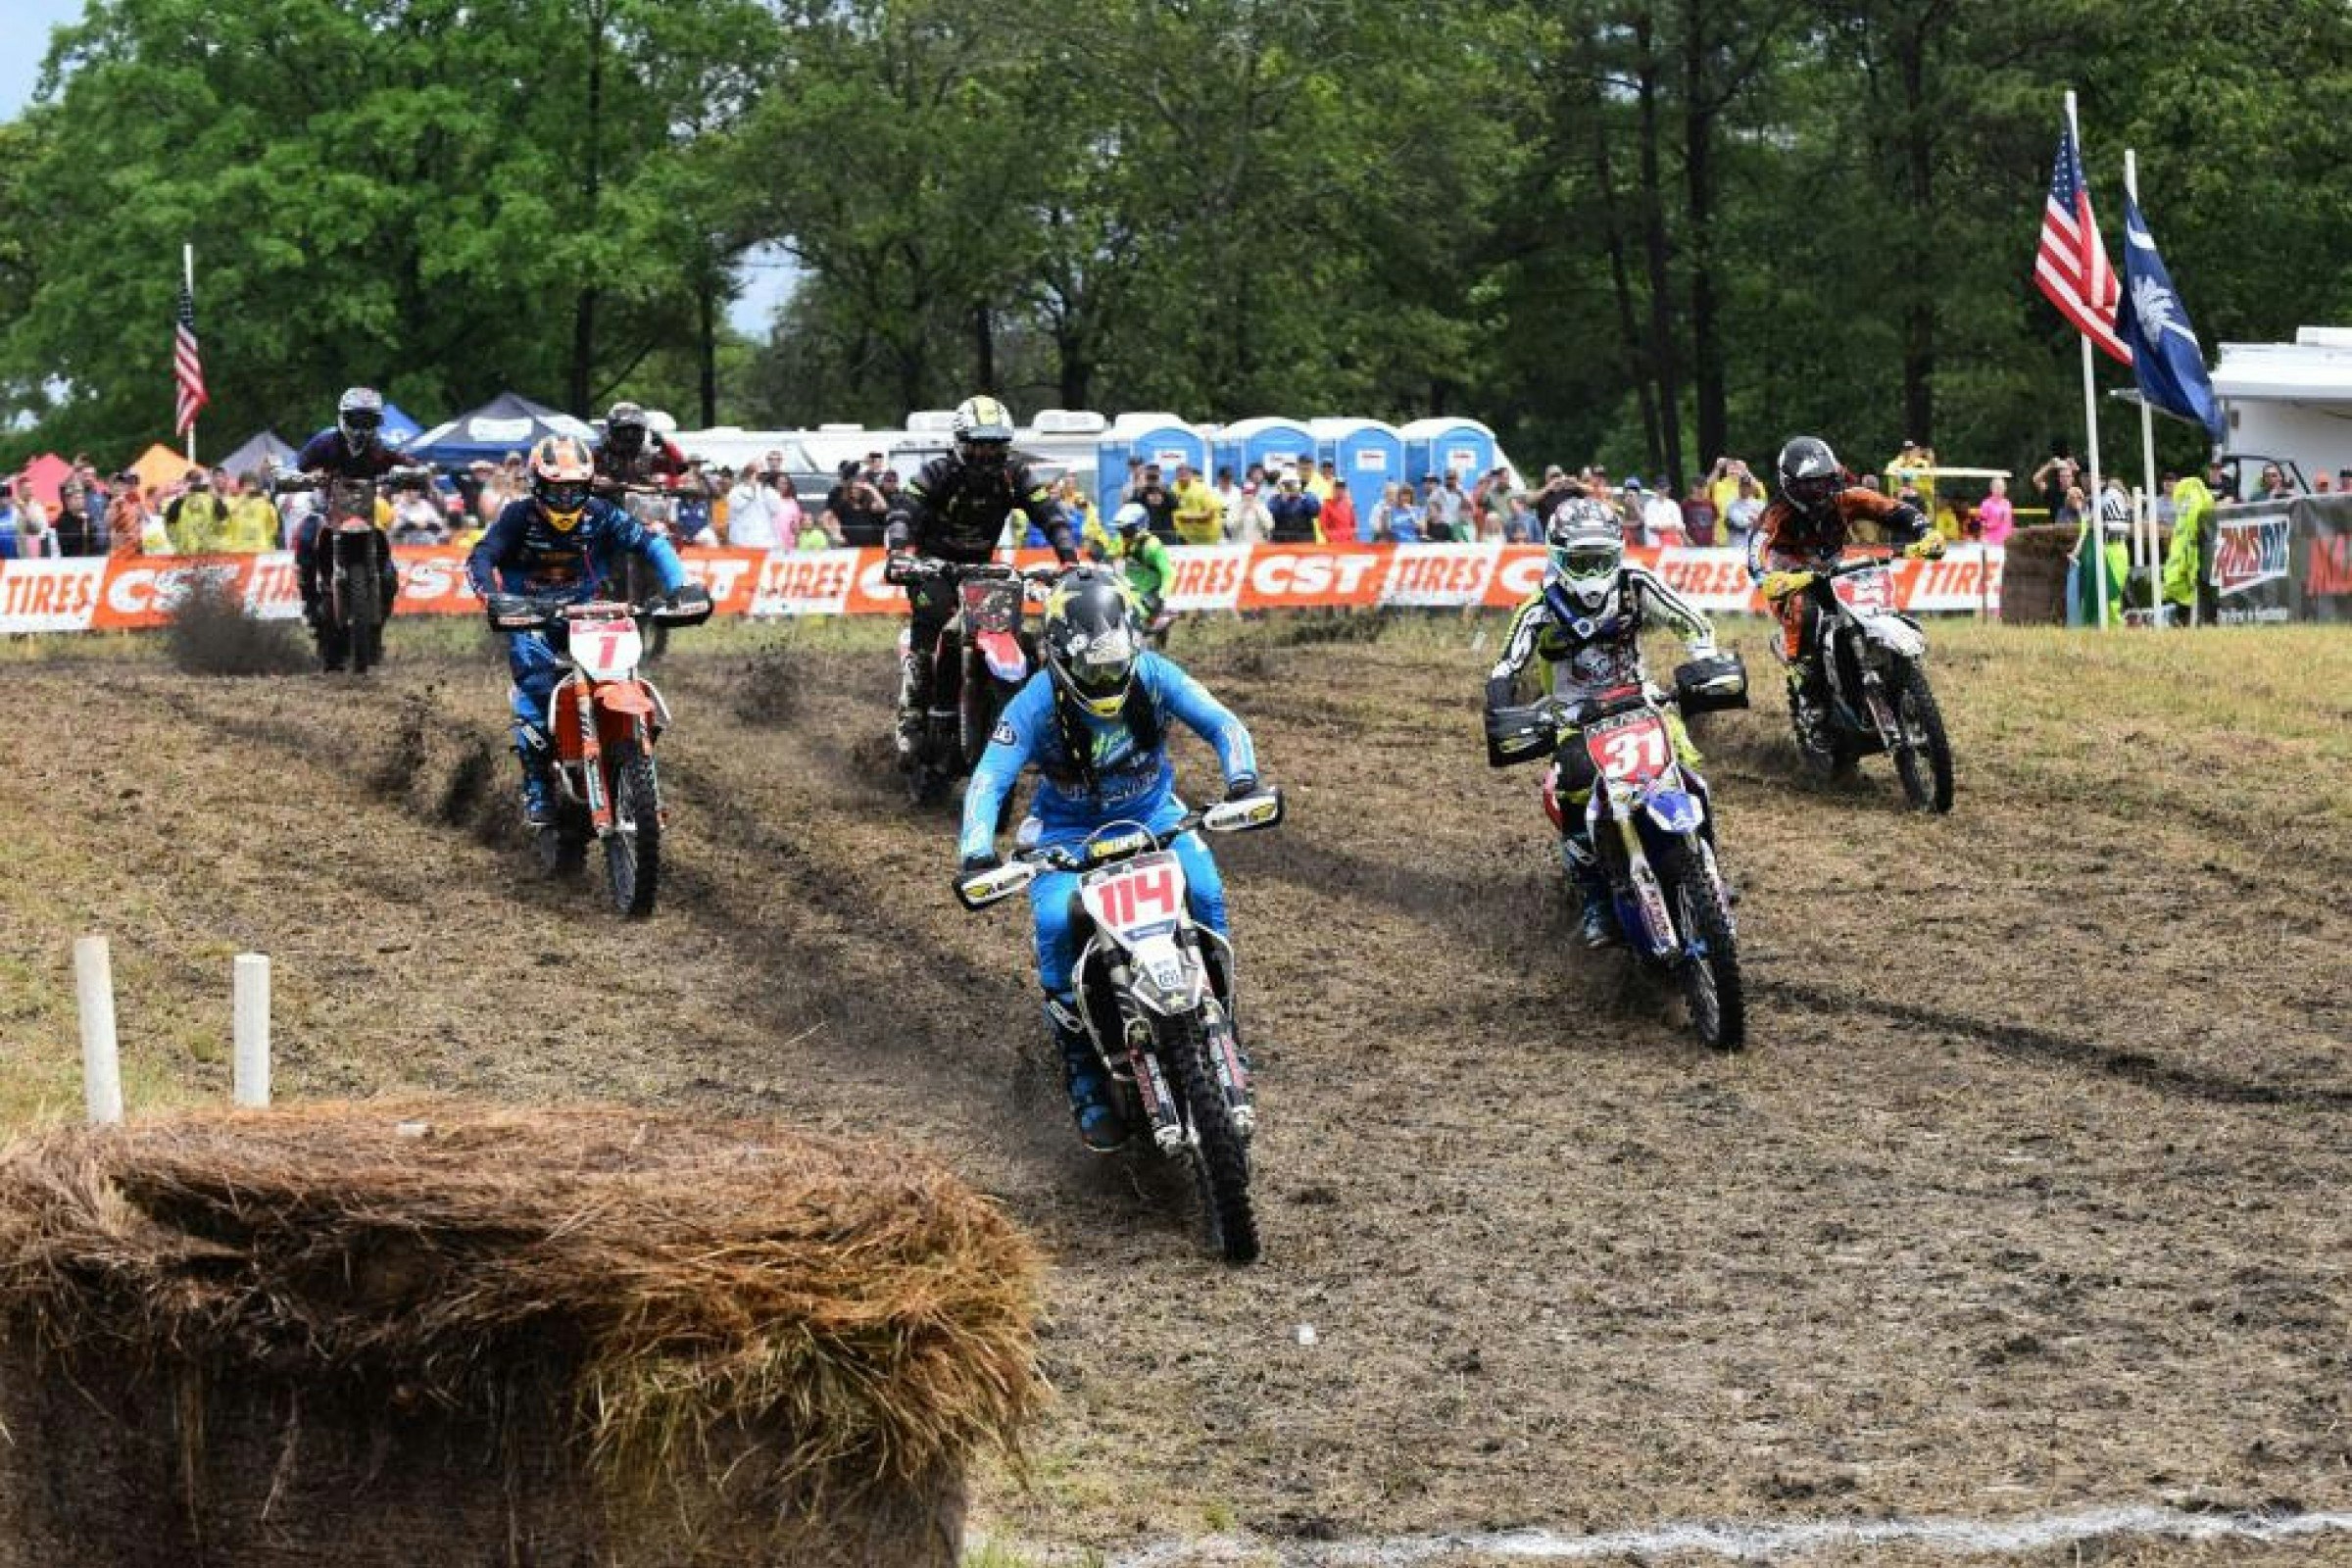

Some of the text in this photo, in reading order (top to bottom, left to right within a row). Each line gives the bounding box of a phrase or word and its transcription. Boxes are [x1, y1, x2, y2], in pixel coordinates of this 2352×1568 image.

[5, 572, 95, 615] TIRES
[766, 561, 848, 599] TIRES
[1174, 558, 1239, 595] IRES
[1251, 554, 1377, 594] CST
[1396, 556, 1489, 593] TIRES
[1665, 561, 1747, 594] TIRES
[597, 635, 619, 669] 1
[1603, 727, 1664, 778] 31
[1098, 869, 1176, 928] 114
